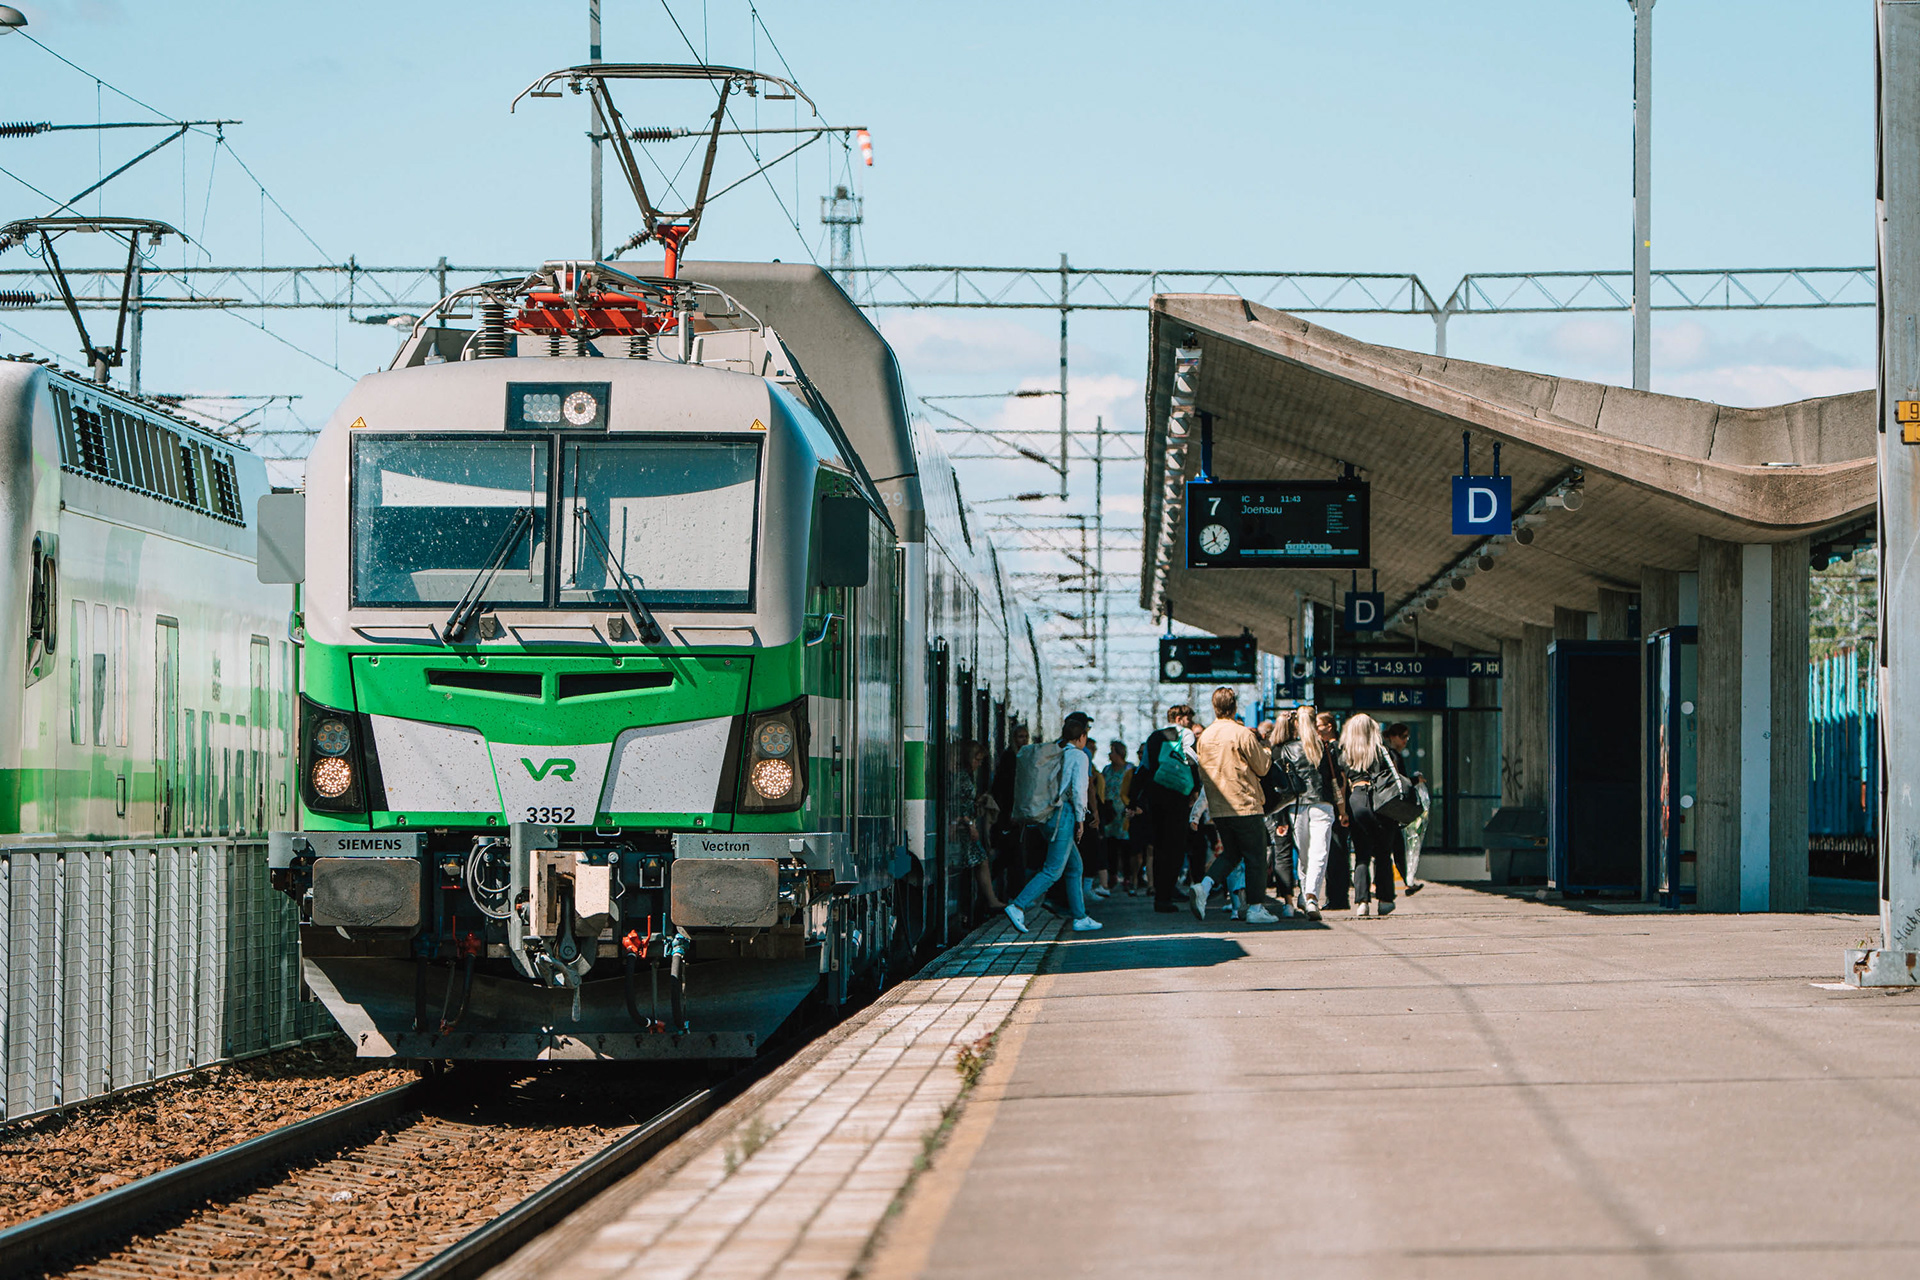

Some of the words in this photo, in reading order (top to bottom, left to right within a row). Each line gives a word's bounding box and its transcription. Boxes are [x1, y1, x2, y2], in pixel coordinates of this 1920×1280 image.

[1208, 497, 1222, 516] 7
[1241, 495, 1251, 503] IC
[1259, 495, 1265, 503] 3
[1280, 495, 1301, 503] 11:43
[1468, 487, 1498, 523] D
[1241, 504, 1283, 515] Joensuu
[1355, 599, 1376, 624] D
[1374, 661, 1422, 675] 1-4,9,10
[520, 757, 577, 782] VR
[526, 806, 576, 824] 3352
[338, 839, 402, 851] SIEMENS
[701, 840, 750, 852] Vectron
